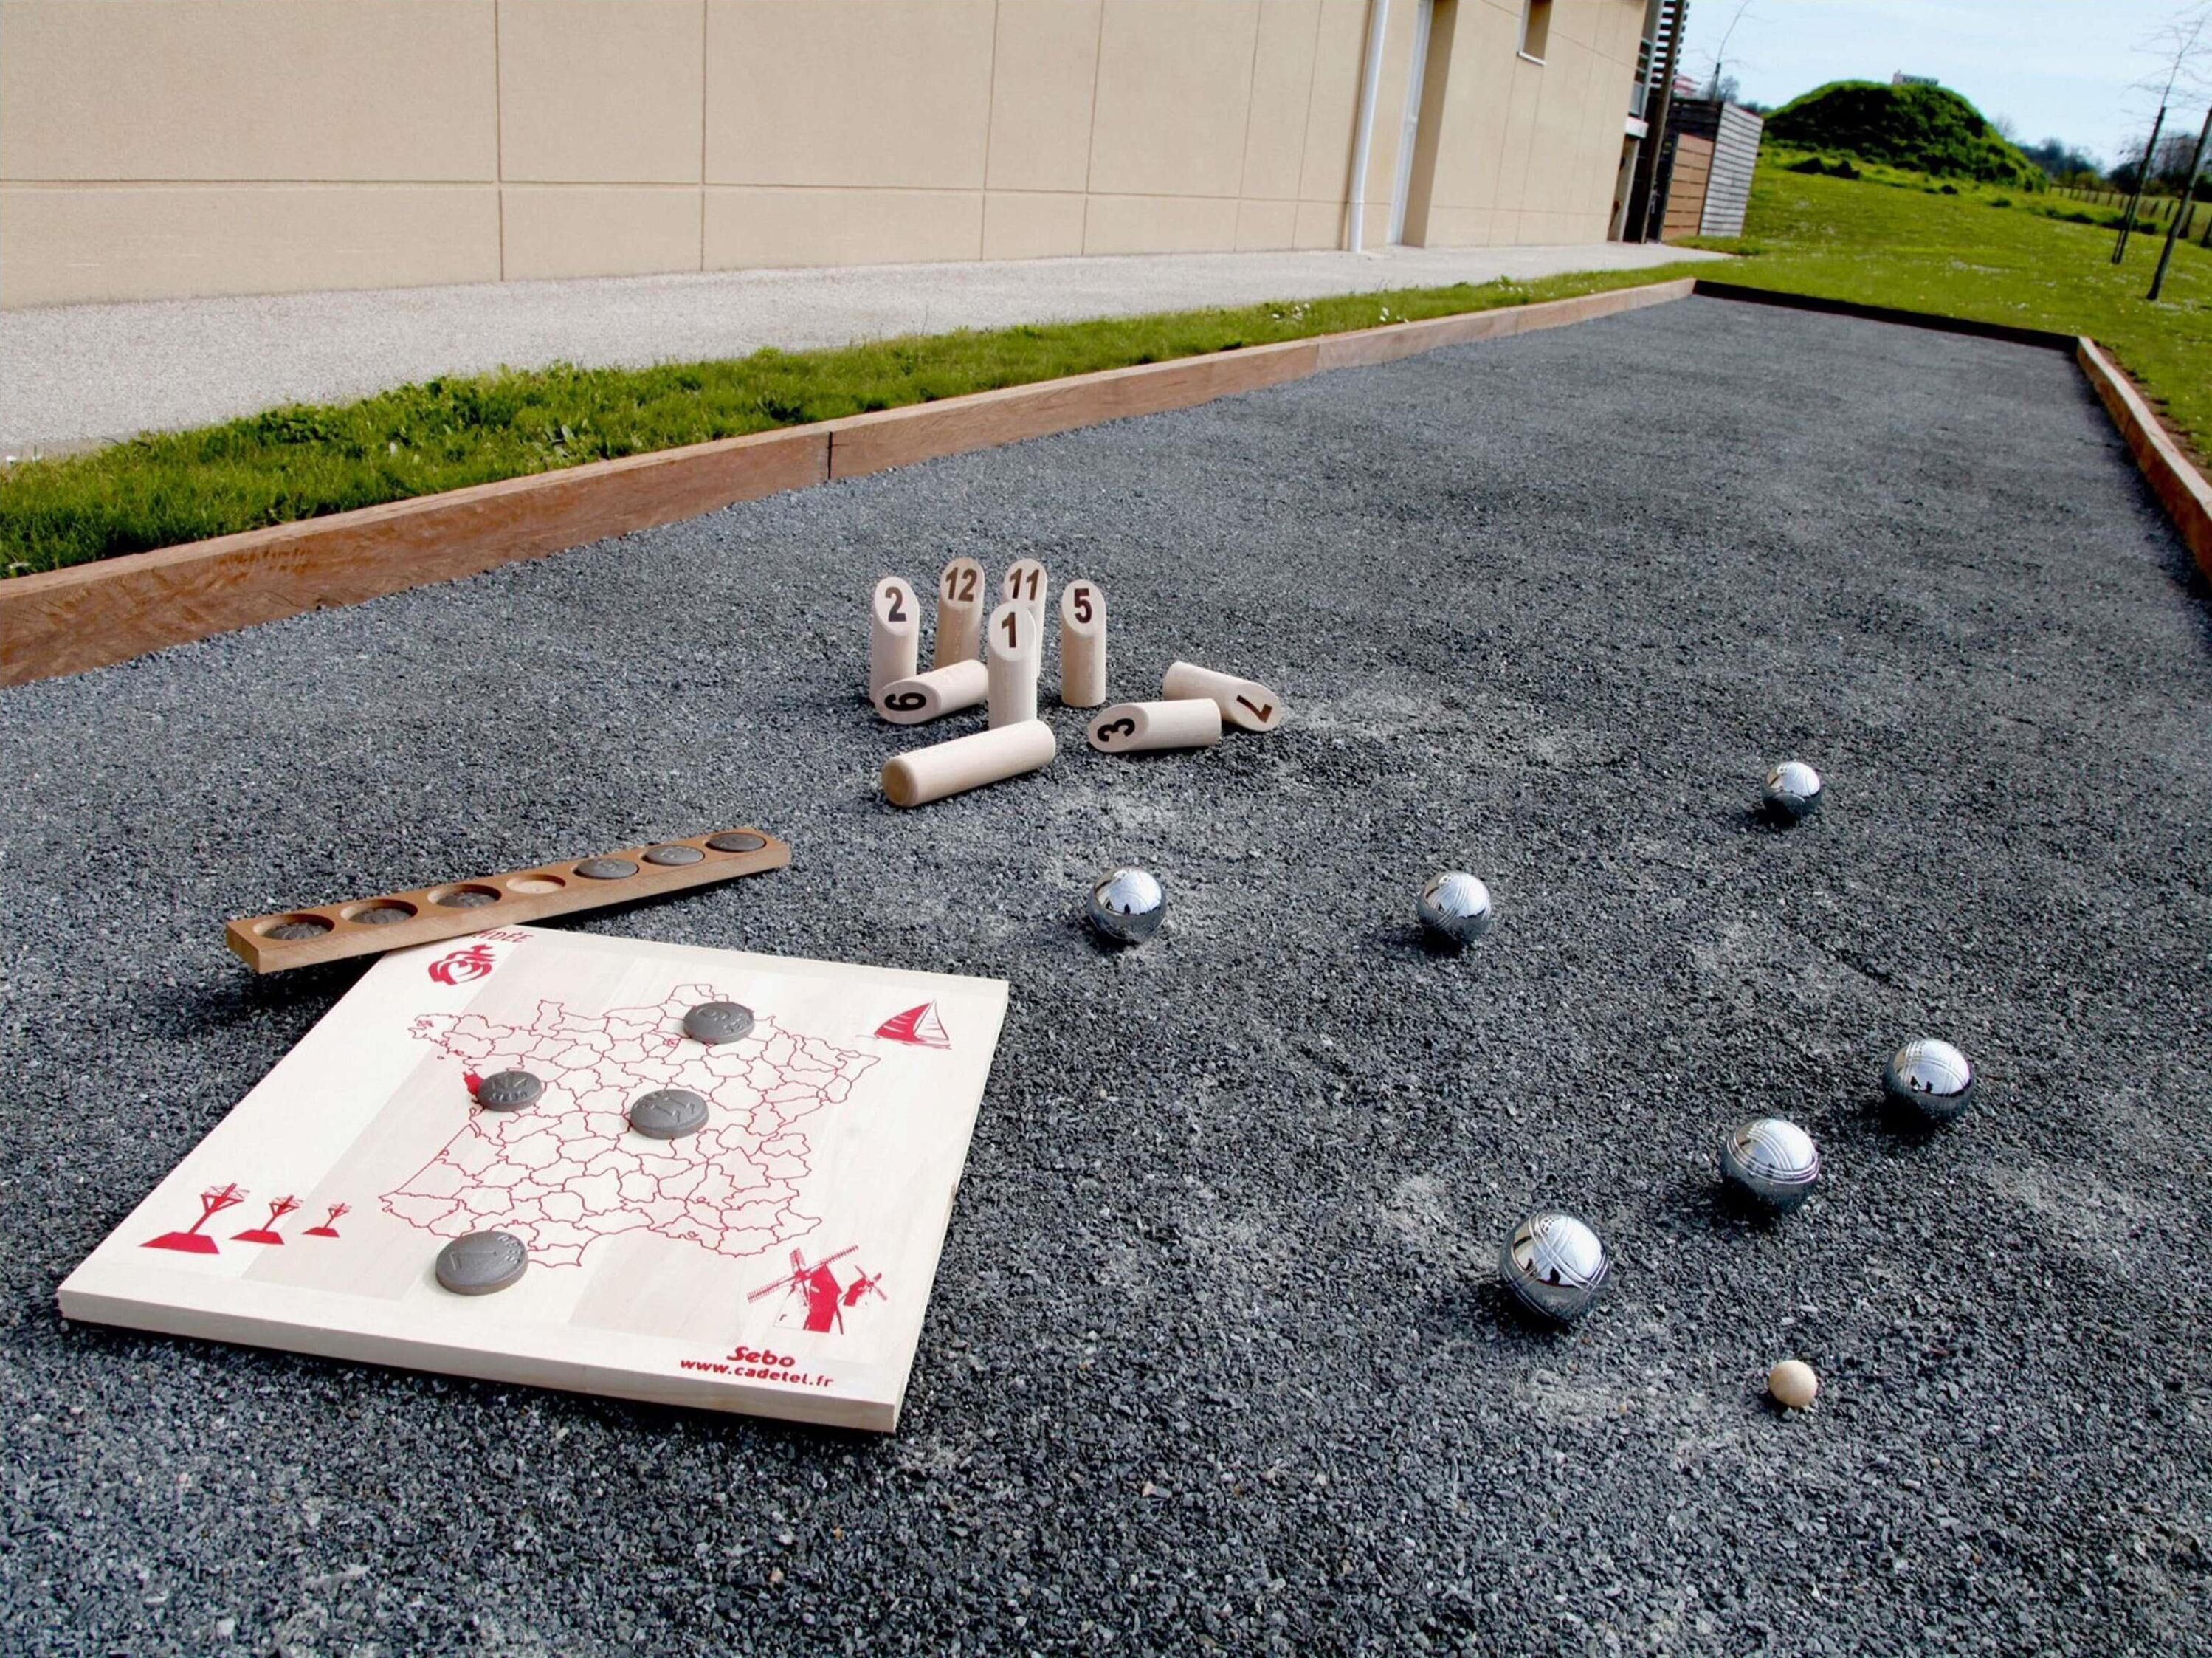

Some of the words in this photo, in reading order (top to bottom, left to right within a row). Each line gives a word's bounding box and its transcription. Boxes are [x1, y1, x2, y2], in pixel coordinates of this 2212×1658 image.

[945, 566, 978, 602] 12
[1008, 568, 1040, 601] 11
[885, 586, 907, 622] 2
[1074, 588, 1092, 623] 5
[1001, 612, 1017, 648] 1
[1236, 695, 1272, 723] 7
[1097, 718, 1135, 743] 3
[680, 1359, 833, 1387] www.cadetel.fr
[726, 1346, 795, 1367] Sebo
